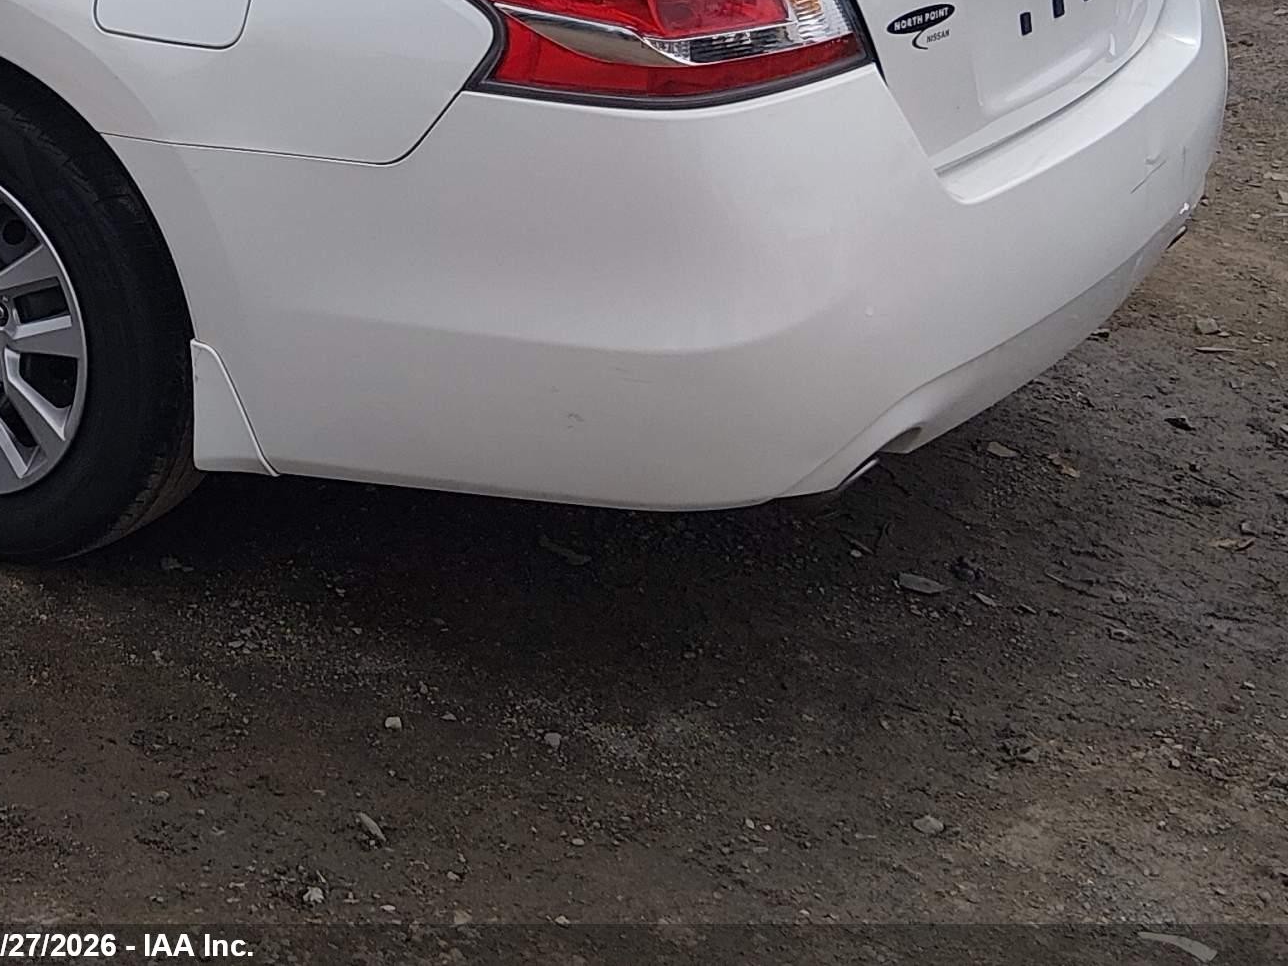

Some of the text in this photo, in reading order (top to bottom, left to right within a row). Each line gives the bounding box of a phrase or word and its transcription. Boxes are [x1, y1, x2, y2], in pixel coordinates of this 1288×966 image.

[894, 7, 949, 31] NORTH POINT
[926, 29, 950, 43] NISSAN
